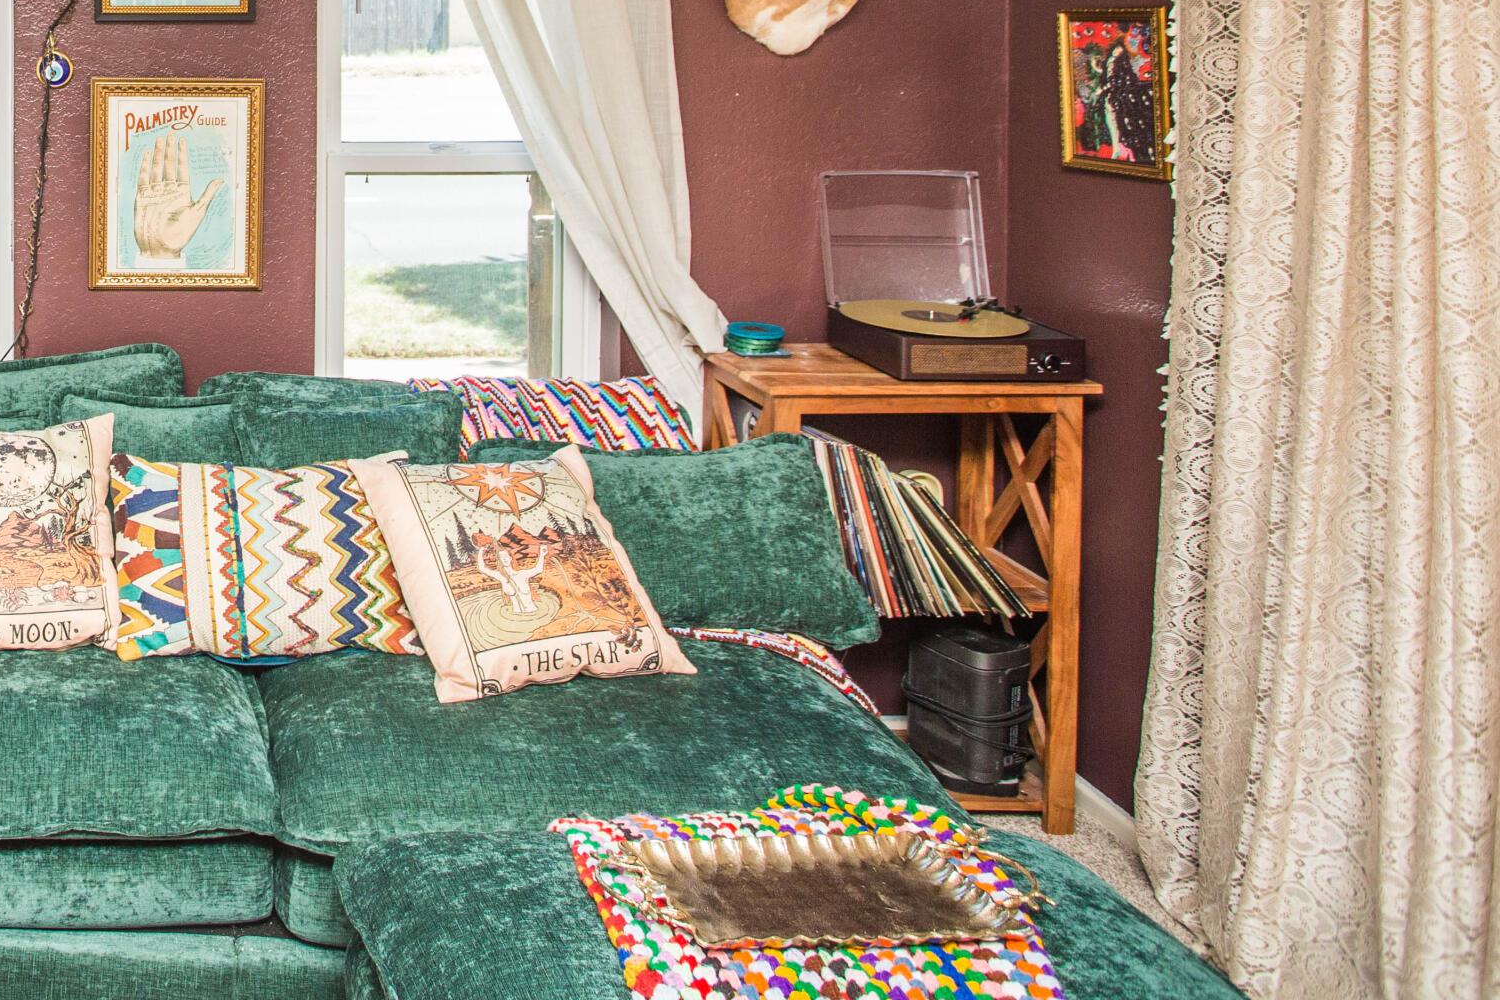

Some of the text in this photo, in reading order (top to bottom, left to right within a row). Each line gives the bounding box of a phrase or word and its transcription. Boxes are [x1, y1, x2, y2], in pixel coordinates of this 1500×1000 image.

[124, 104, 198, 152] PALMISTRY
[196, 114, 227, 126] GUIDE
[9, 620, 72, 645] MOON
[521, 640, 620, 676] THE STAR
